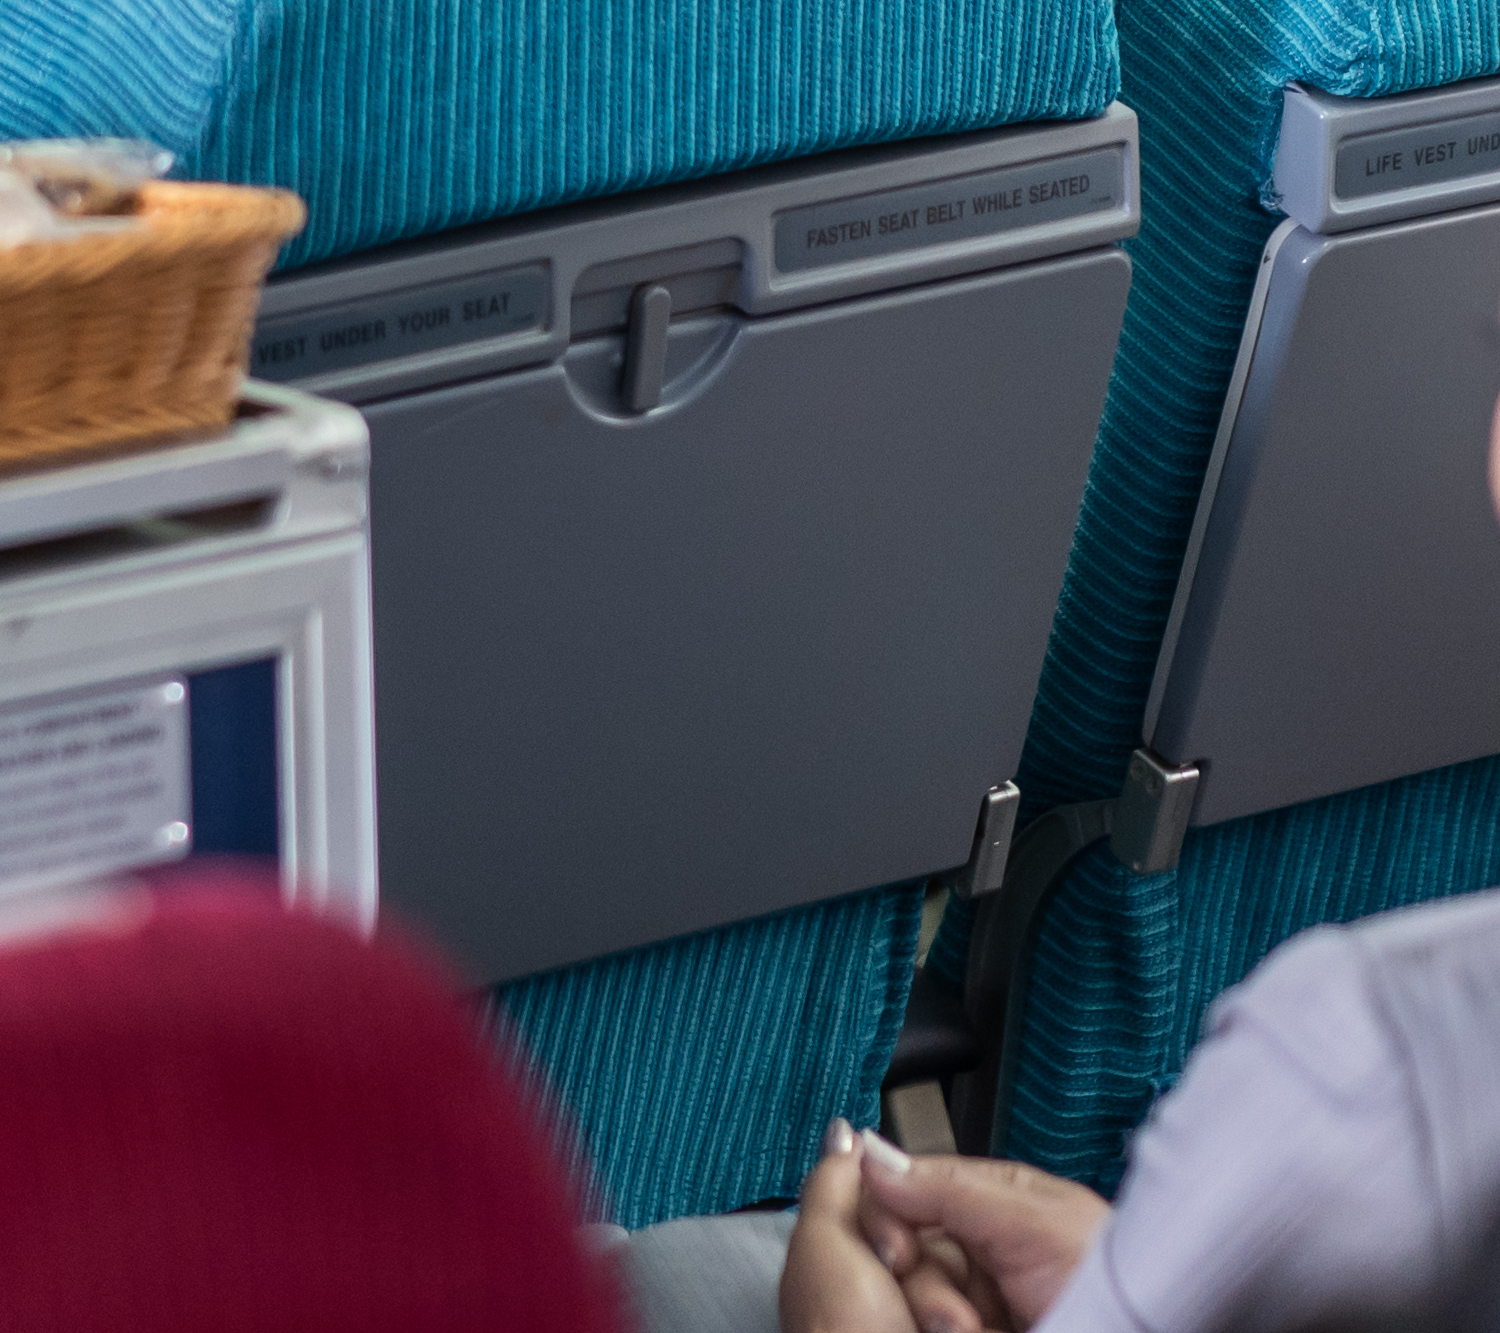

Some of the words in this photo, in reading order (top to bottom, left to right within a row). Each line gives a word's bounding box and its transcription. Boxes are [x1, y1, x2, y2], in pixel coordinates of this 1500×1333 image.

[1365, 153, 1402, 177] LIFE
[1414, 142, 1456, 166] VEST
[807, 219, 871, 248] FASTEN
[878, 208, 919, 235] SEAT
[926, 200, 966, 226] BELT
[973, 188, 1022, 215] WHILE
[1029, 174, 1090, 204] SEATED
[258, 338, 307, 364] VEST
[321, 320, 386, 352] UNDER
[399, 307, 450, 335] YOUR
[462, 292, 511, 321] SEAT
